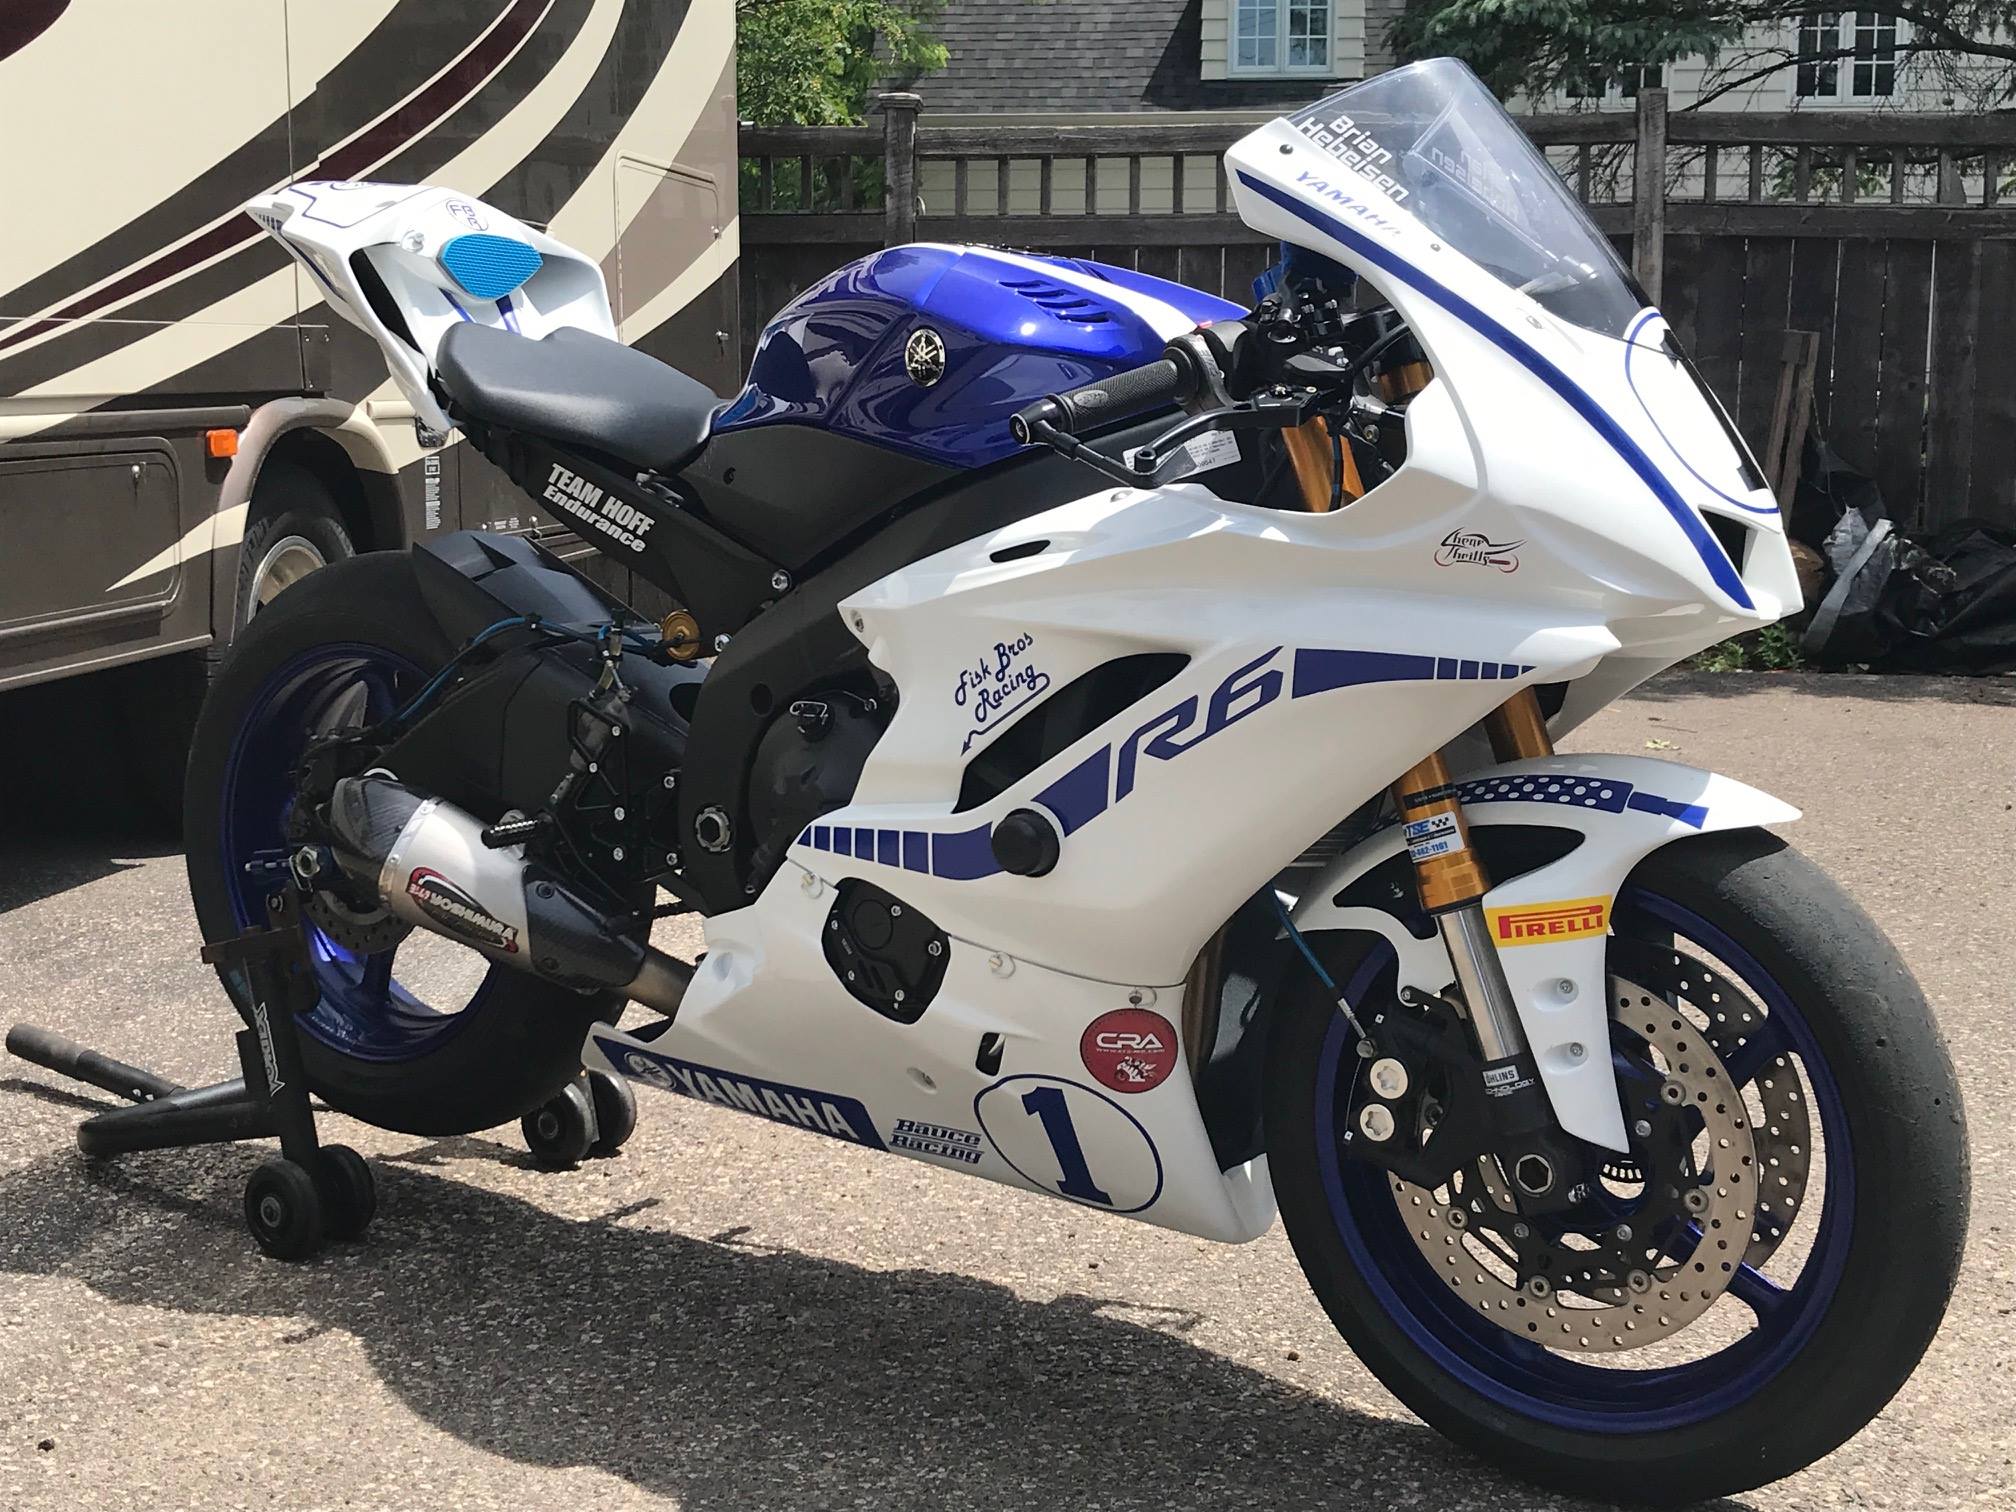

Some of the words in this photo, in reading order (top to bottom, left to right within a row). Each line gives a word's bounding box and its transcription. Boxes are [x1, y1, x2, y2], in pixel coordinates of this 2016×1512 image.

[1297, 116, 1410, 202] Hebeisen
[1329, 115, 1392, 165] Brian
[542, 485, 647, 553] Endurance
[548, 463, 603, 507] TEAM
[601, 496, 655, 537] HOFF
[955, 658, 991, 706] Fisk
[994, 632, 1034, 682] Bros
[975, 664, 1038, 723] Racing
[1115, 645, 1284, 804] R6
[1498, 905, 1604, 939] PIRELLI
[1096, 1033, 1164, 1049] CRA
[665, 1064, 860, 1140] YAMAHA
[889, 1134, 984, 1164] Racing
[1021, 1086, 1114, 1206] 1
